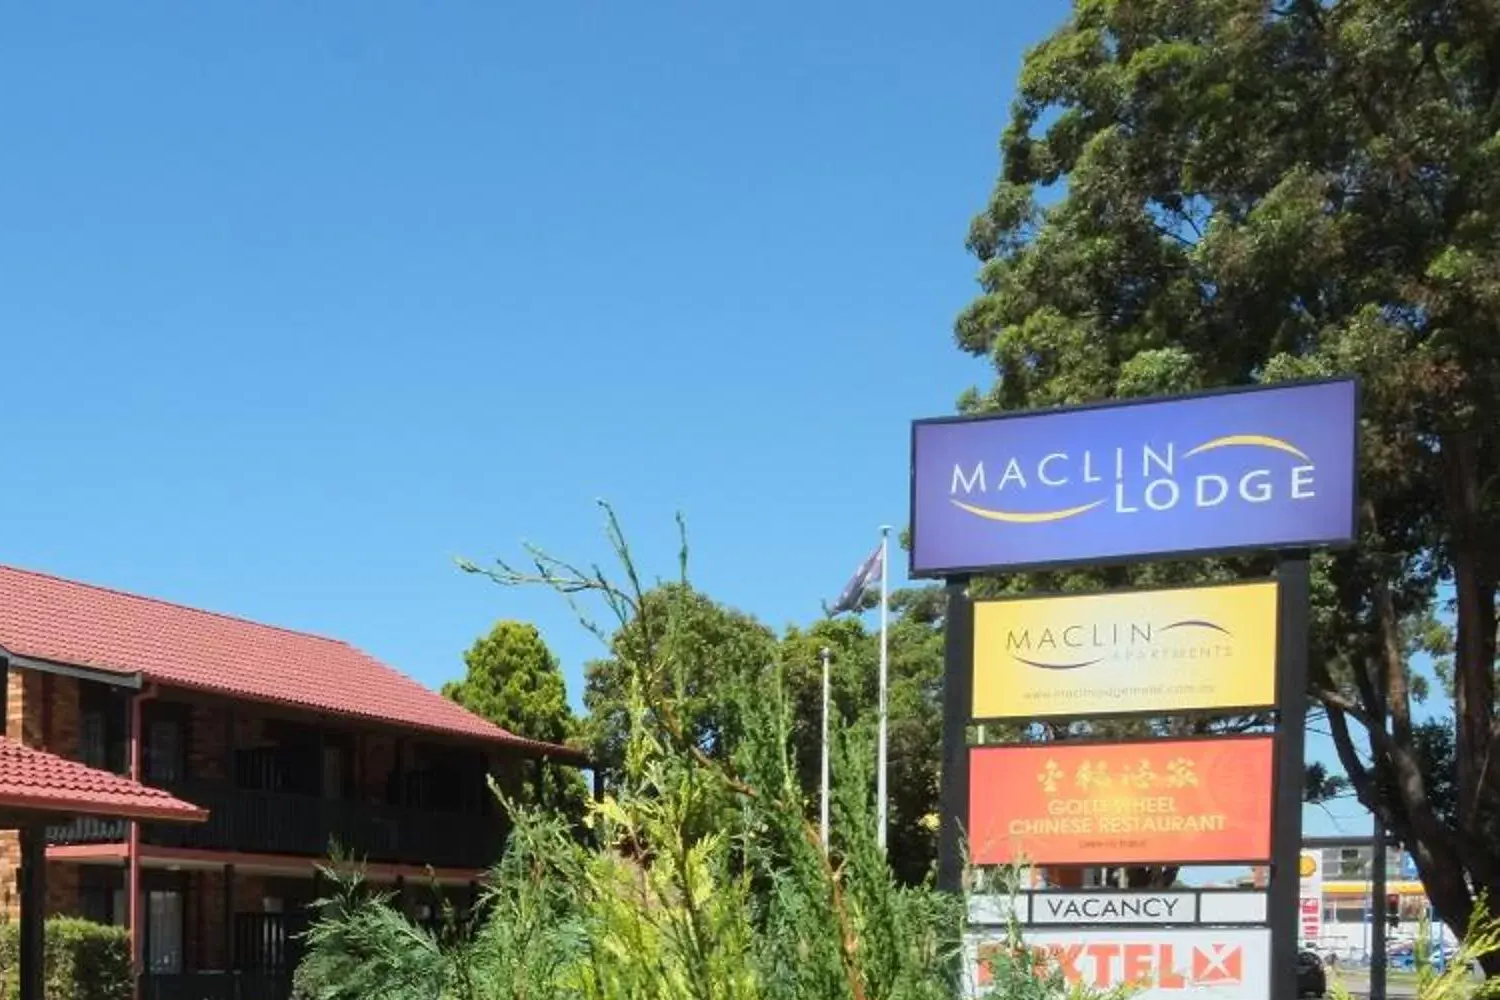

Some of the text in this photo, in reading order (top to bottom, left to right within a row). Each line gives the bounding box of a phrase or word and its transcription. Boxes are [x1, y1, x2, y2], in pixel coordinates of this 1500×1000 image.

[950, 442, 1174, 494] MACLIN
[1115, 464, 1315, 513] LODGE
[1006, 623, 1152, 650] MACLIN
[1008, 814, 1228, 836] CHINESE RESTAURANT
[1048, 898, 1179, 917] VACANCY
